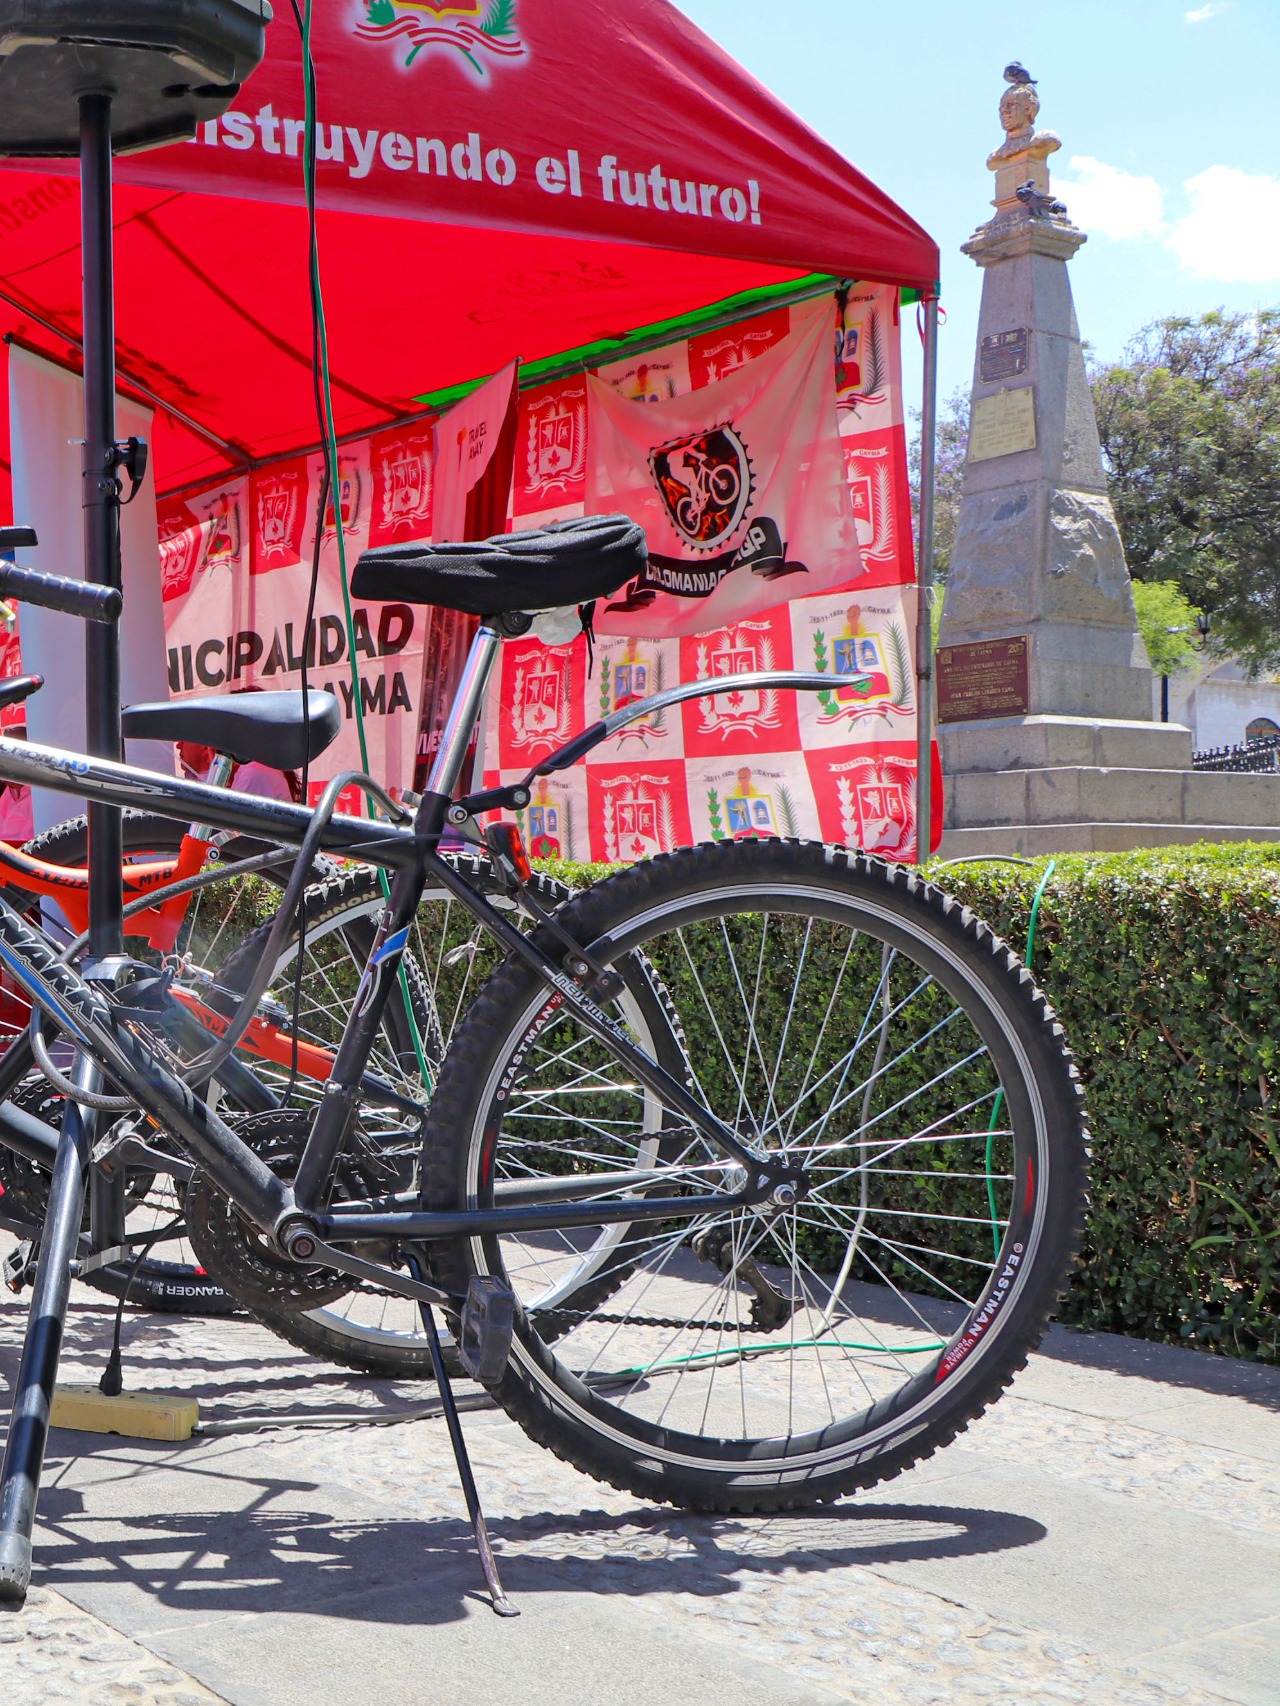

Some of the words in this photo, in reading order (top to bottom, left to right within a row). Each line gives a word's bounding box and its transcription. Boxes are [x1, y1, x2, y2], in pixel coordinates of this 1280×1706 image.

[535, 149, 582, 197] el
[597, 154, 762, 225] futuro!
[813, 610, 843, 623] 12-11-1823
[867, 606, 891, 615] CAYMA
[745, 621, 764, 629] CAYMA
[835, 757, 868, 771] 12-11-1823
[892, 757, 914, 765] CAYMA
[646, 775, 664, 783] CAYMA
[757, 770, 781, 778] CAYMA
[552, 780, 569, 789] CAYMA
[138, 866, 173, 888] MTB
[500, 1005, 555, 1089] EASTMAN
[166, 1285, 224, 1296] RANGER
[968, 1254, 1020, 1337] EASTMAN
[945, 1337, 968, 1362] POWER
[945, 1338, 975, 1370] ULTIMATE
